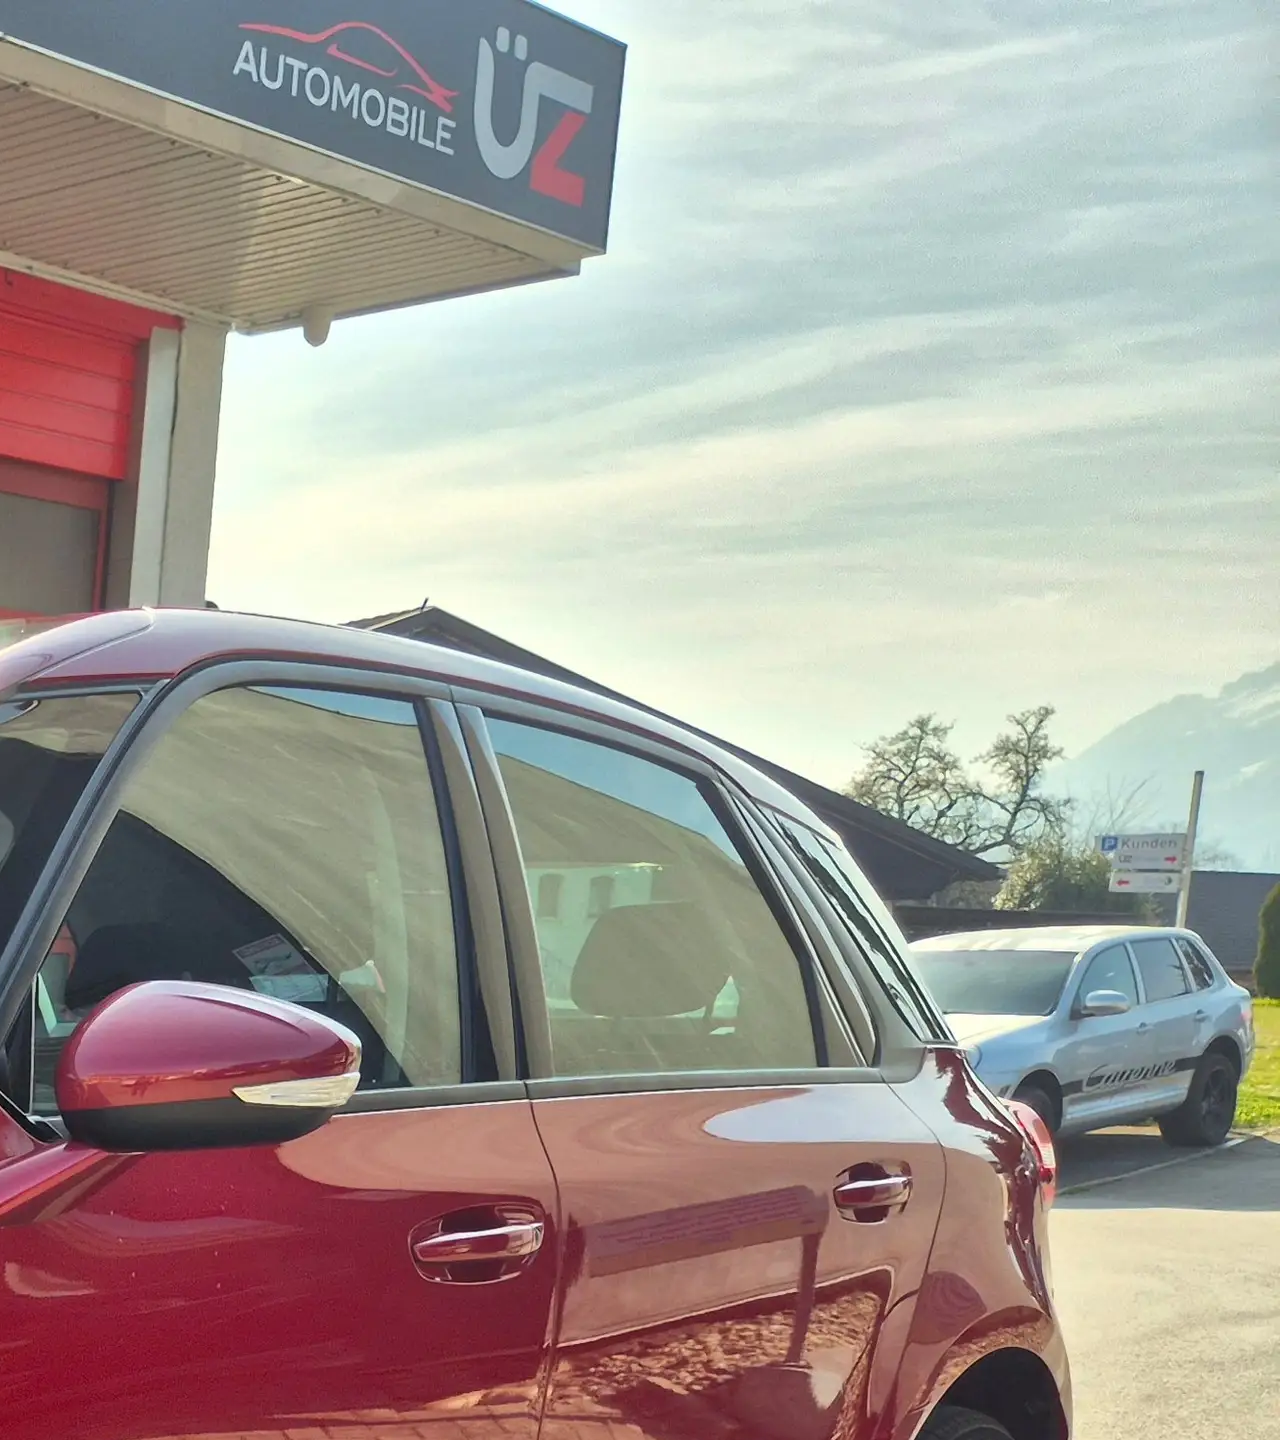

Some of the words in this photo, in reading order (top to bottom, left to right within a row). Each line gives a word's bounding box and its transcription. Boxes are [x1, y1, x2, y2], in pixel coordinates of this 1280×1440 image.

[233, 39, 457, 157] AUTOMOBILE
[1105, 838, 1115, 850] P
[1121, 837, 1178, 850] Kunden
